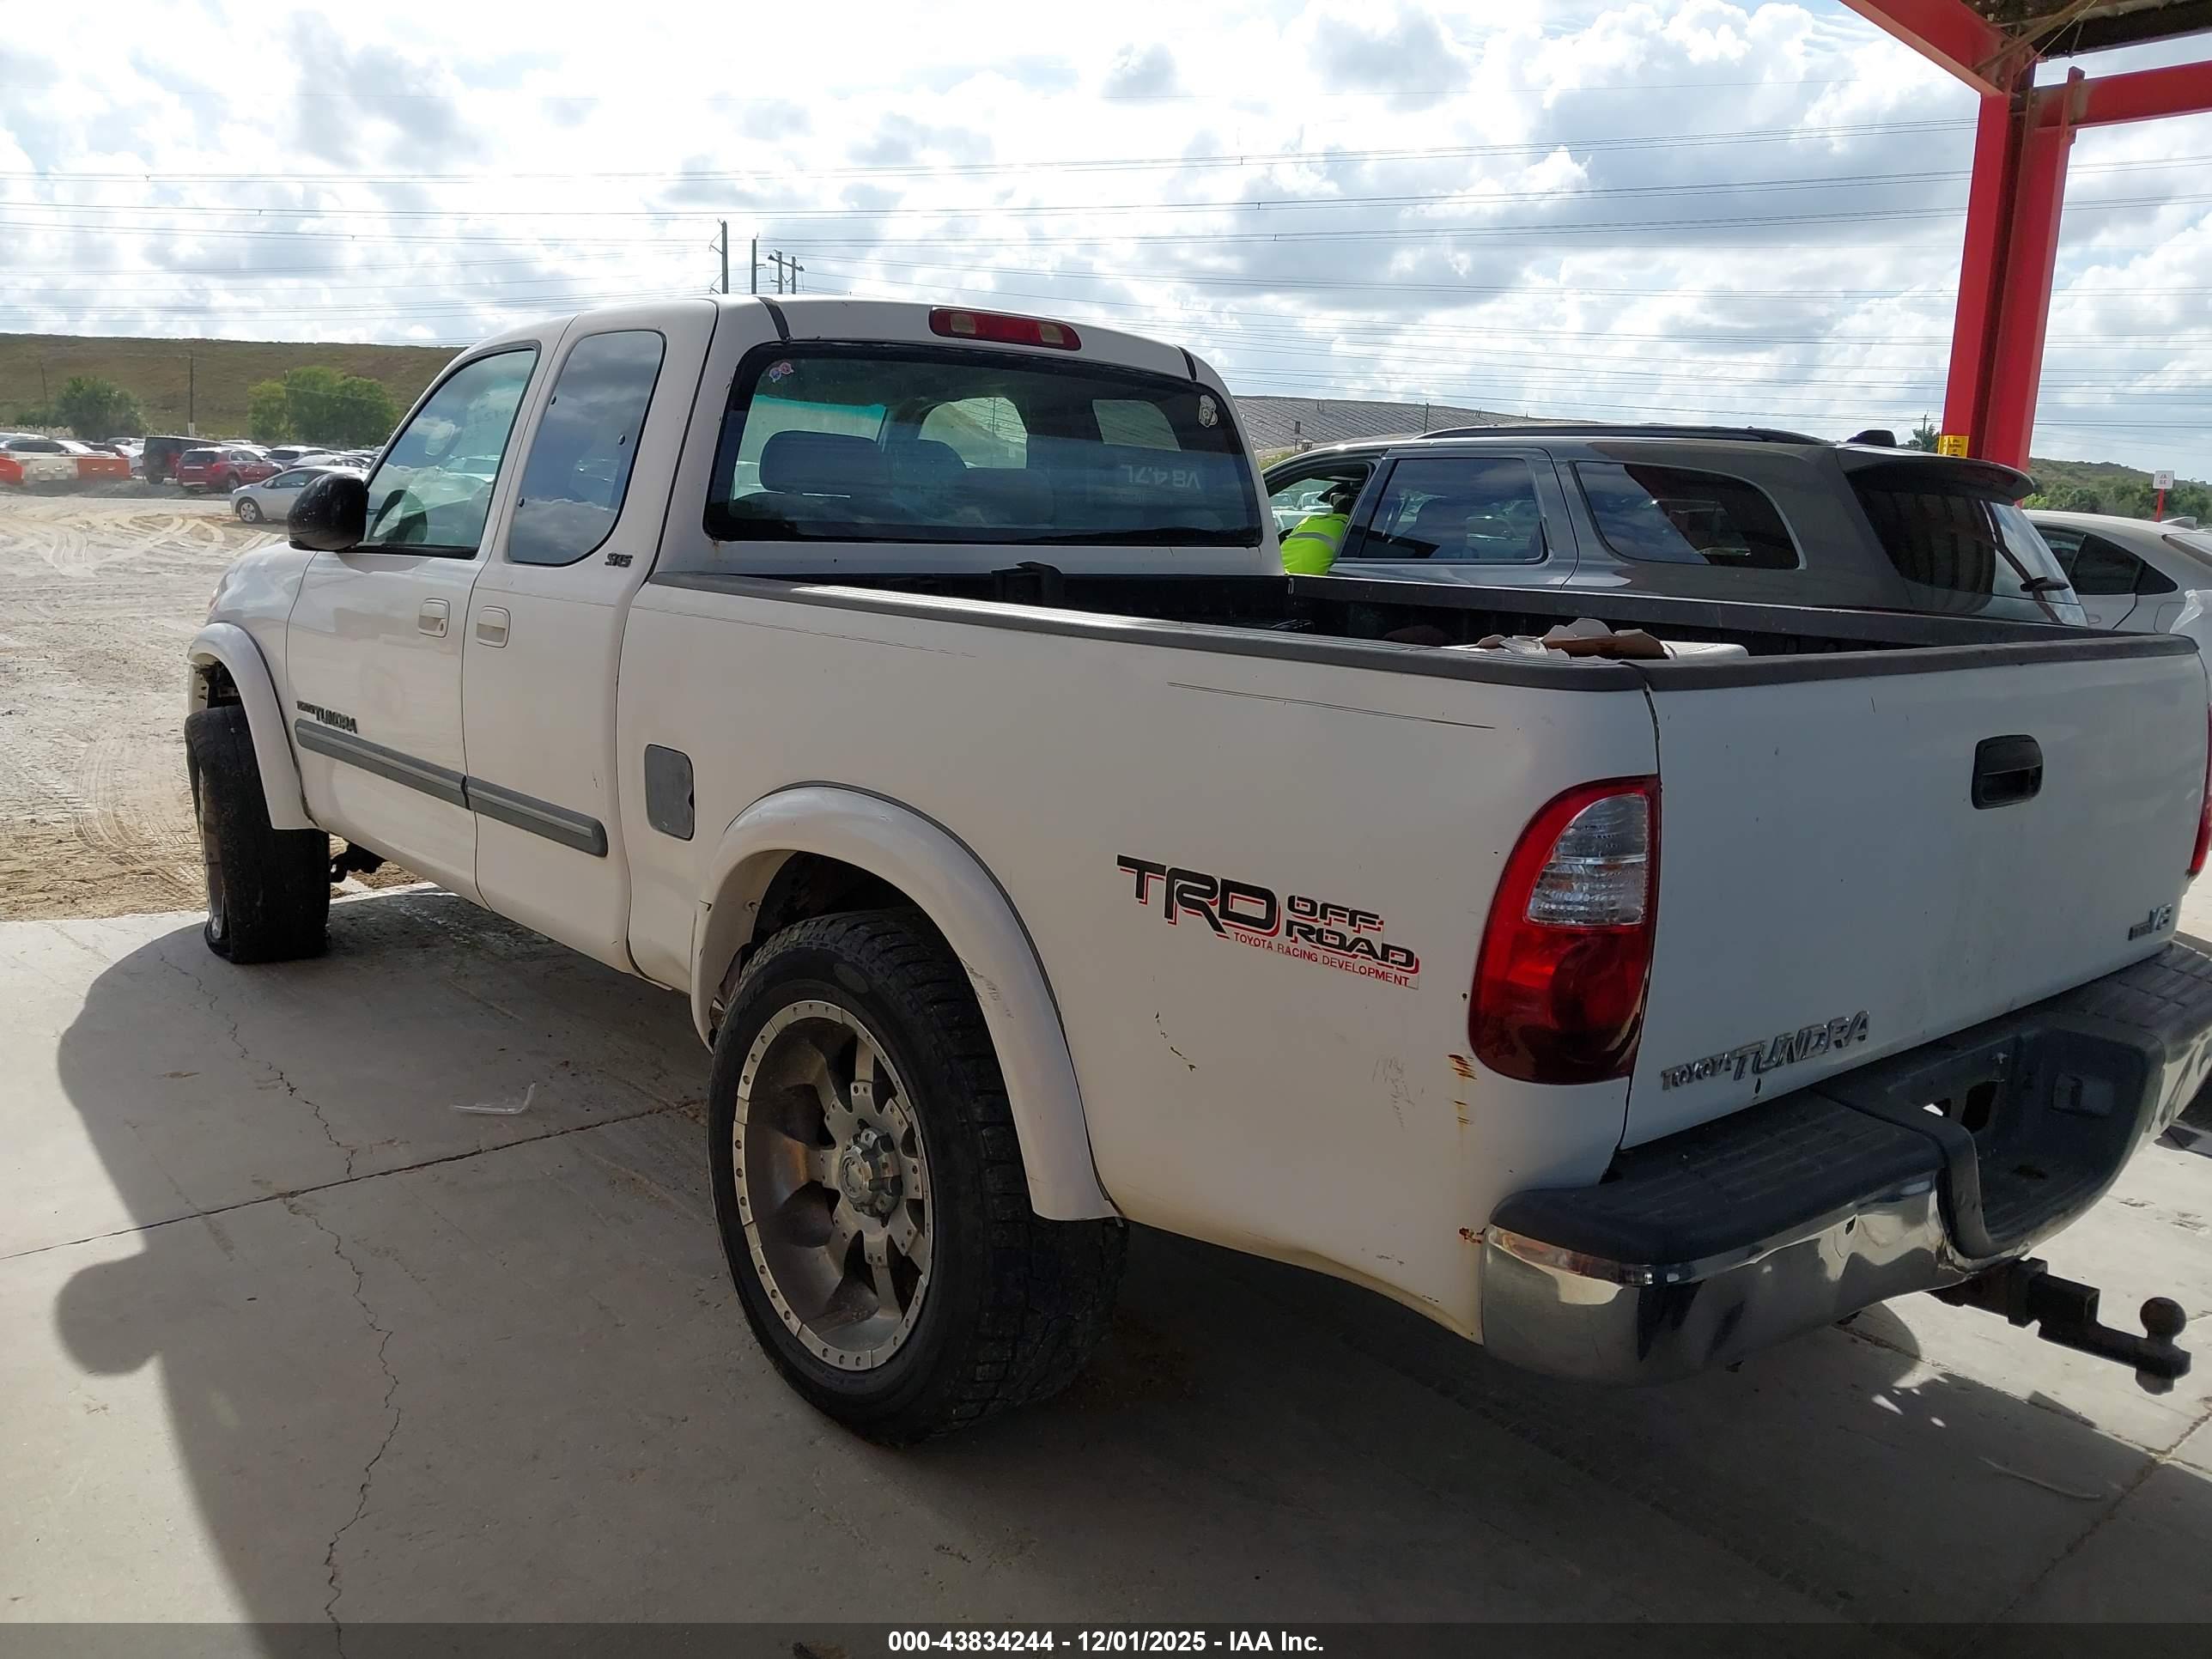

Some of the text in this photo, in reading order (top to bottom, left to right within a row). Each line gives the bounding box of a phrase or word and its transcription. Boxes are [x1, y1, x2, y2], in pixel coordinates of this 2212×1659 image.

[1116, 854, 1281, 939] TRD
[1287, 895, 1383, 933] OFF
[1233, 932, 1410, 987] TOYOTA RACING DEVELOPMENT
[1285, 919, 1419, 974] ROAD
[1661, 1011, 1869, 1091] TOYOTA TUNDRA
